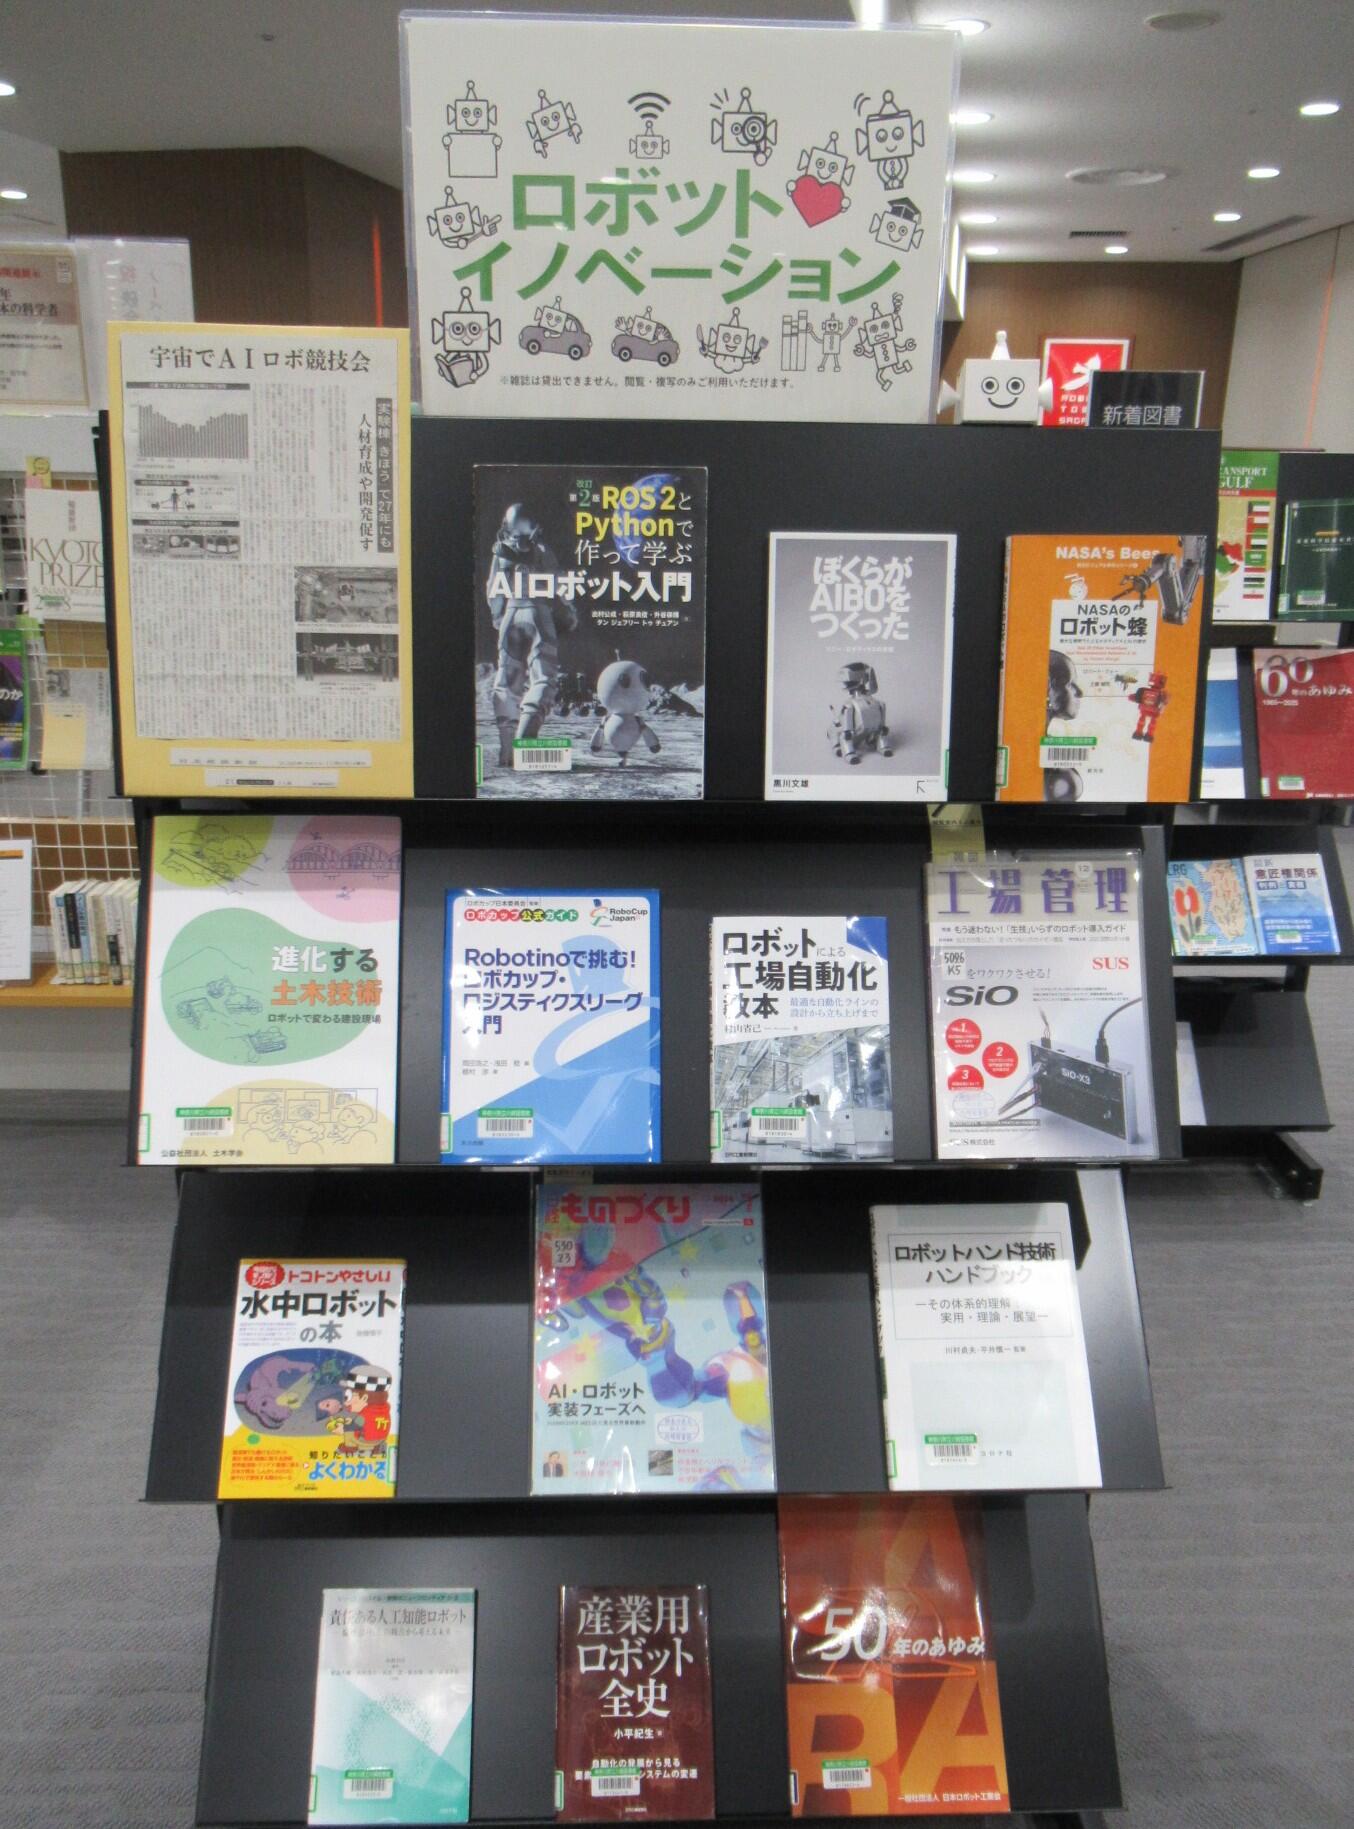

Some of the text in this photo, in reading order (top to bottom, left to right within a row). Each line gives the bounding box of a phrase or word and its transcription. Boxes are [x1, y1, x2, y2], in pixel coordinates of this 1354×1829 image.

[511, 165, 784, 240] ロボット
[452, 241, 902, 305] イノベーション
[1103, 405, 1182, 426] 新着図書
[359, 413, 373, 549] 人材育成や開発促す
[602, 485, 657, 511] ROS
[576, 511, 694, 542] Pythonで
[574, 540, 692, 566] 作って学ぶ
[1055, 547, 1115, 560] NASA's
[813, 556, 913, 585] ぼくらが
[488, 569, 692, 602] AIロボット入門
[809, 583, 911, 613] AIBOを
[1077, 604, 1131, 616] NASAの
[809, 612, 910, 640] つくった
[1060, 617, 1149, 637] ロボット蜂
[937, 867, 1129, 915] 工場管理
[465, 909, 579, 922] ロボカップ公式ガイド
[609, 908, 648, 917] RoboCup
[609, 915, 636, 923] Japan
[723, 926, 846, 959] ロボットによる
[272, 946, 378, 973] 進化する
[1092, 957, 1130, 970] SUS
[722, 960, 878, 992] 工場自動化
[271, 979, 383, 1007] 土木技術
[944, 985, 1019, 1007] SiO
[268, 1014, 381, 1025] ロボットで変わる建設現場
[561, 1192, 691, 1224] ものづくり
[895, 1242, 1056, 1263] ロボットハンド技術
[288, 1269, 391, 1284] トコトンやさしい
[926, 1265, 1032, 1285] ハンドブック
[240, 1290, 397, 1319] 水中ロボット
[300, 1320, 343, 1344] の本
[548, 1381, 645, 1400] AI・ロボット
[548, 1402, 647, 1418] 実装フェーズへ
[308, 1461, 386, 1481] よくわかる
[577, 1594, 690, 1636] 産業用
[576, 1636, 694, 1677] ロボット
[599, 1678, 670, 1718] 全史
